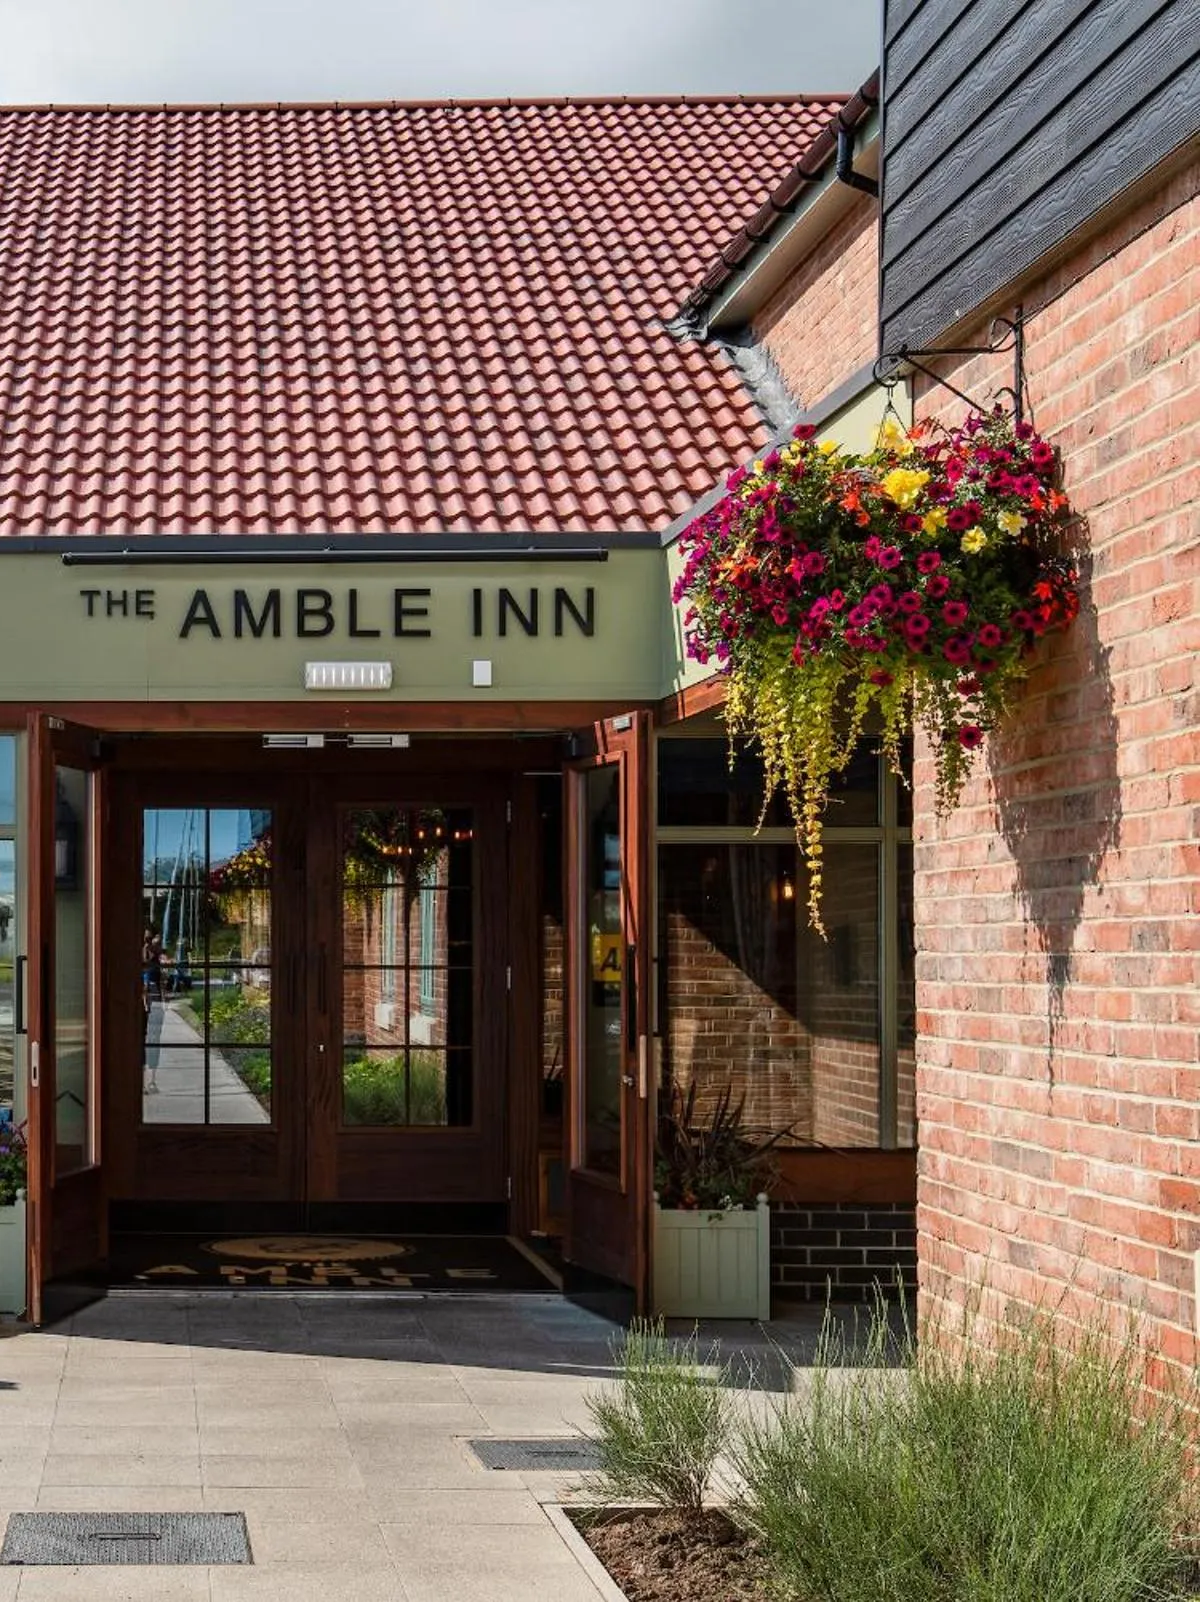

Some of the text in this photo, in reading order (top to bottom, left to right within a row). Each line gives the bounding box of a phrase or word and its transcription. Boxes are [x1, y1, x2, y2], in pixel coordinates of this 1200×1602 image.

[80, 587, 594, 639] THE AMBLE INN
[142, 1265, 498, 1279] AMBLE
